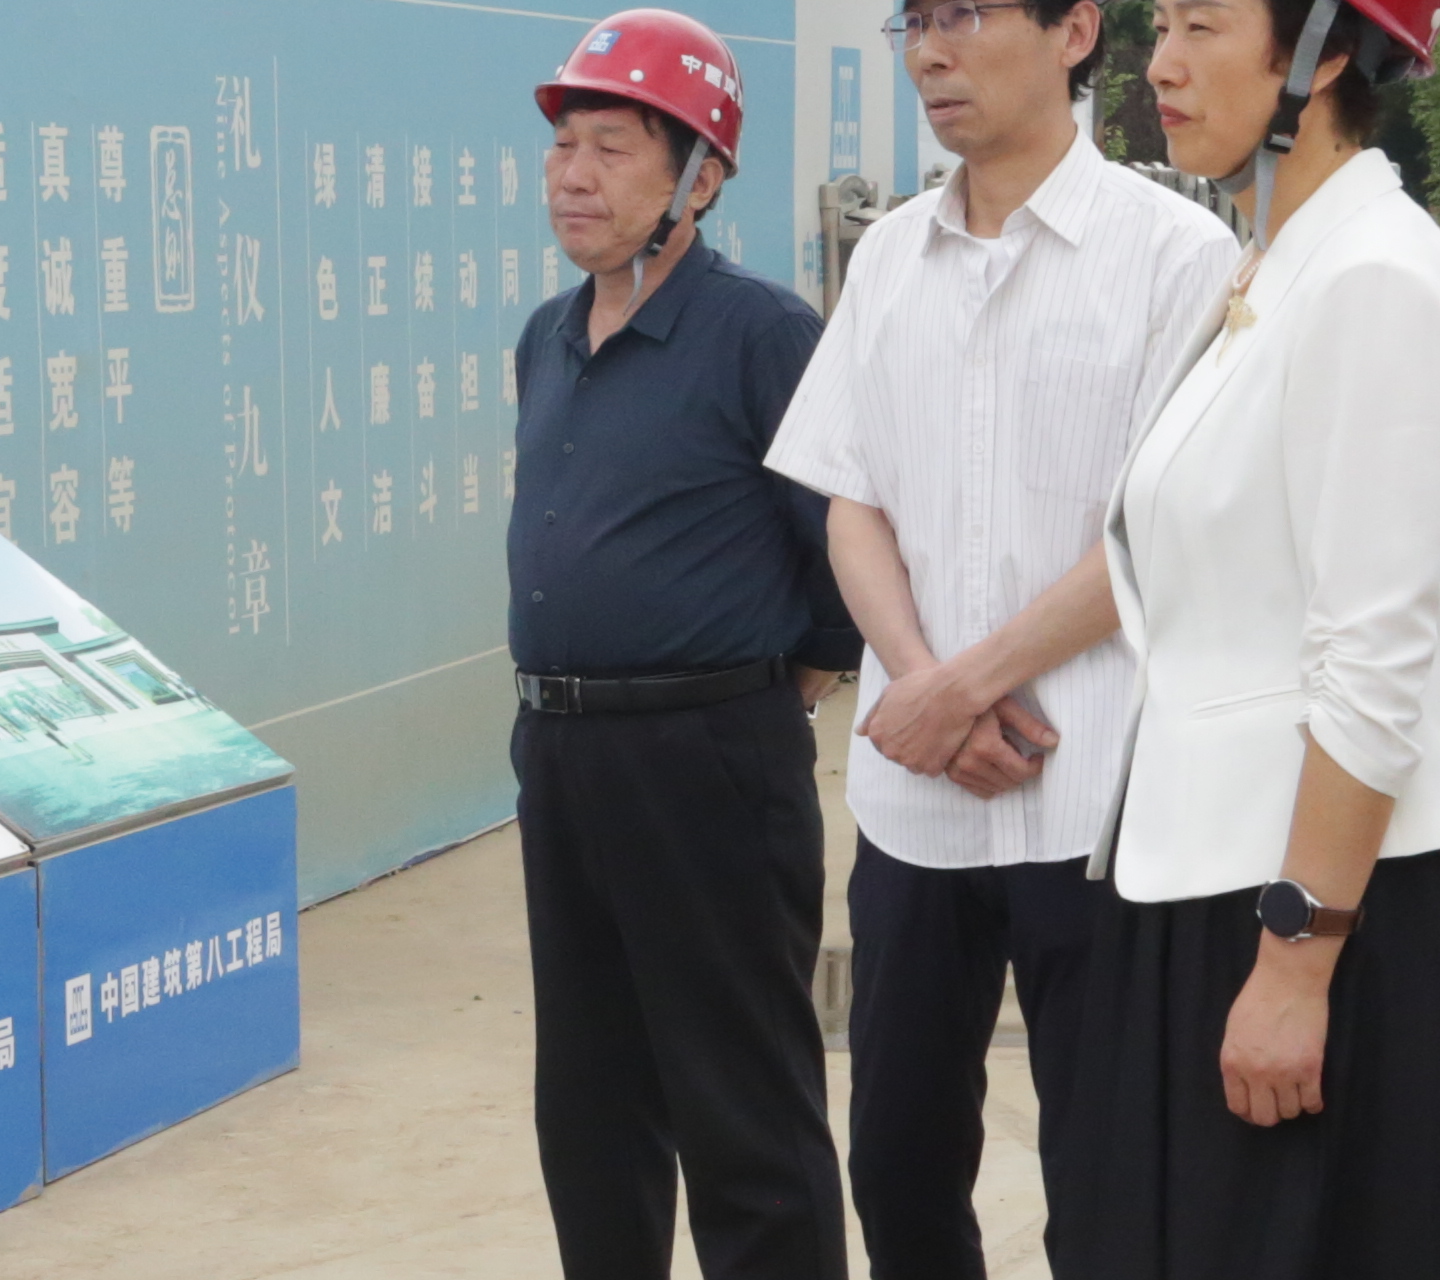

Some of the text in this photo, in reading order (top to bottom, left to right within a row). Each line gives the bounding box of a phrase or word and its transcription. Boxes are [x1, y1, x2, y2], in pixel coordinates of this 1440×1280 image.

[38, 121, 81, 545] 真诚宽容
[97, 124, 136, 534] 尊重平等
[231, 75, 270, 635] 礼仪九章
[313, 142, 344, 546] 绿色人文
[364, 142, 394, 535] 清正廉洁
[412, 143, 438, 524] 接续奋斗
[457, 146, 480, 514] 主动担当
[101, 910, 283, 1025] 中国建筑第八工程局
